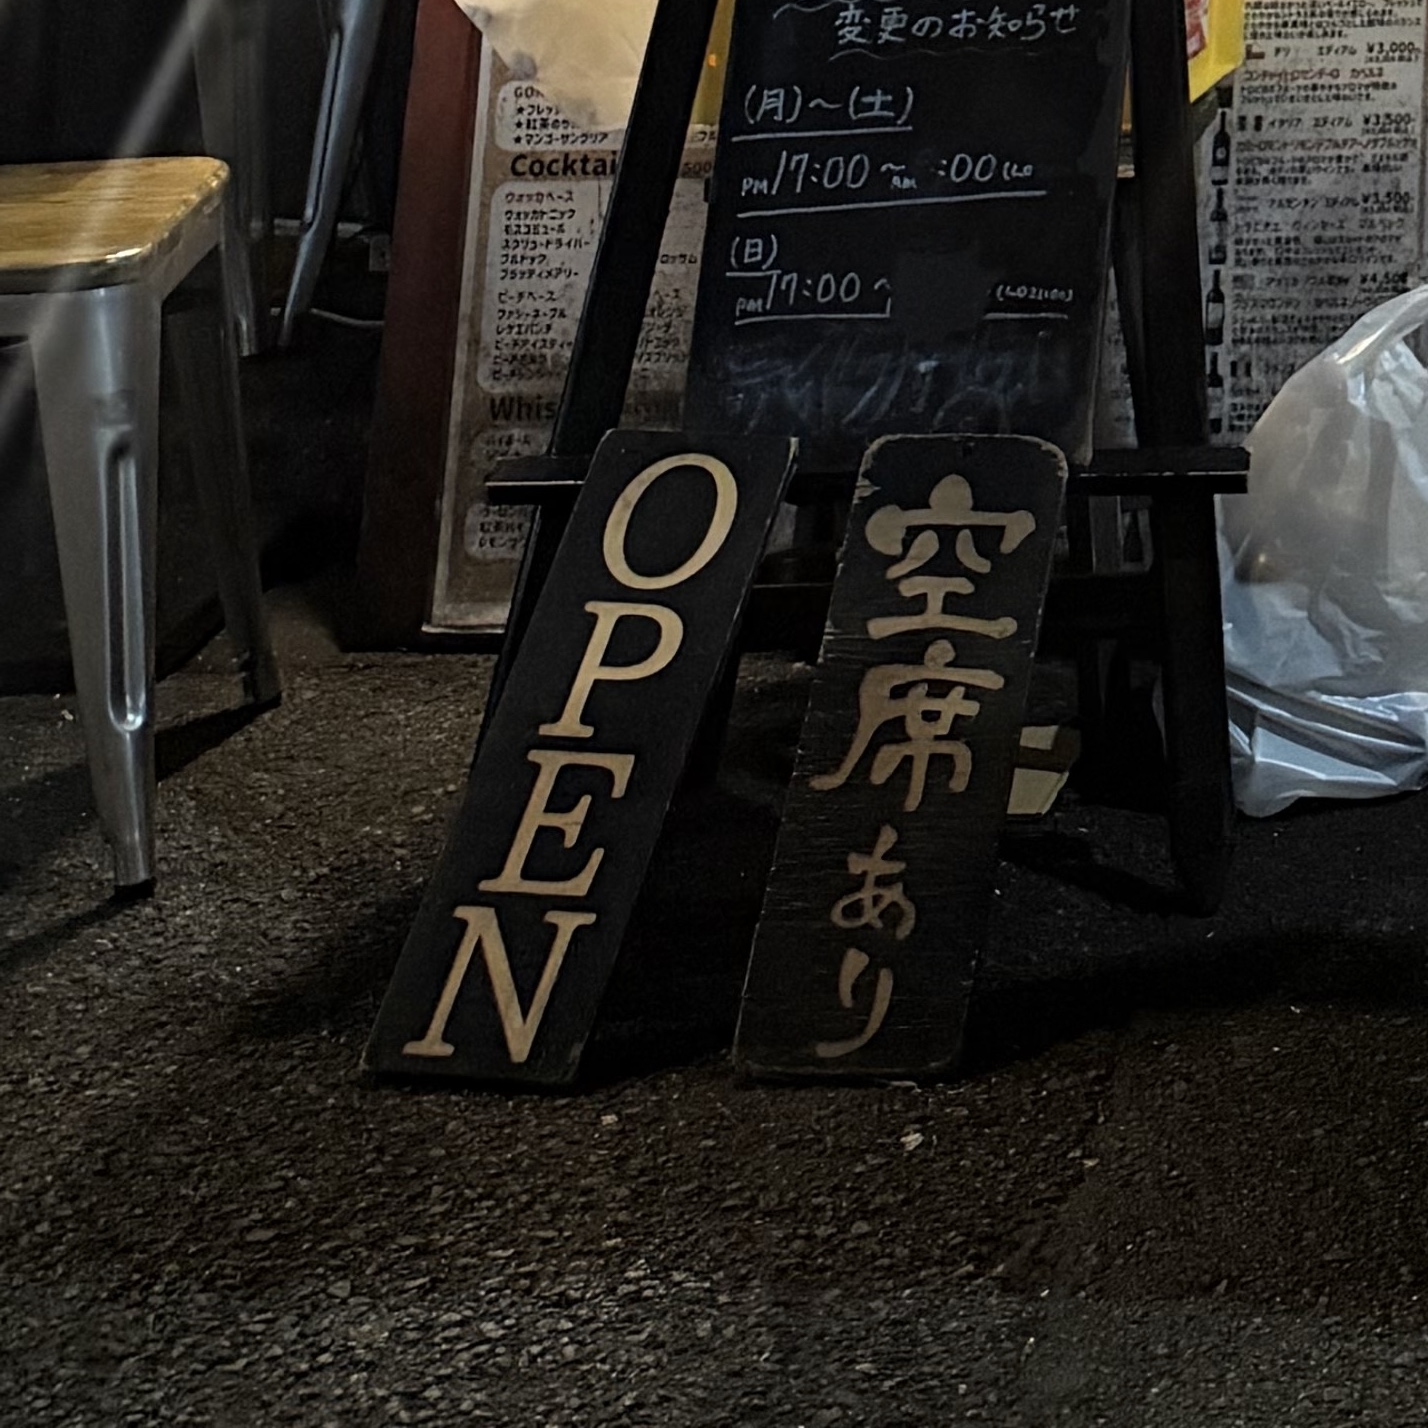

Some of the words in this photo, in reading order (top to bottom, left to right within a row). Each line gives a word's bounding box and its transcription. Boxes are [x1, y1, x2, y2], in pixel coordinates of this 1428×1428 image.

[834, 4, 1082, 45] 変更のお知らせ
[402, 452, 740, 1064] OPEN
[807, 472, 1037, 1061] 空席あり
